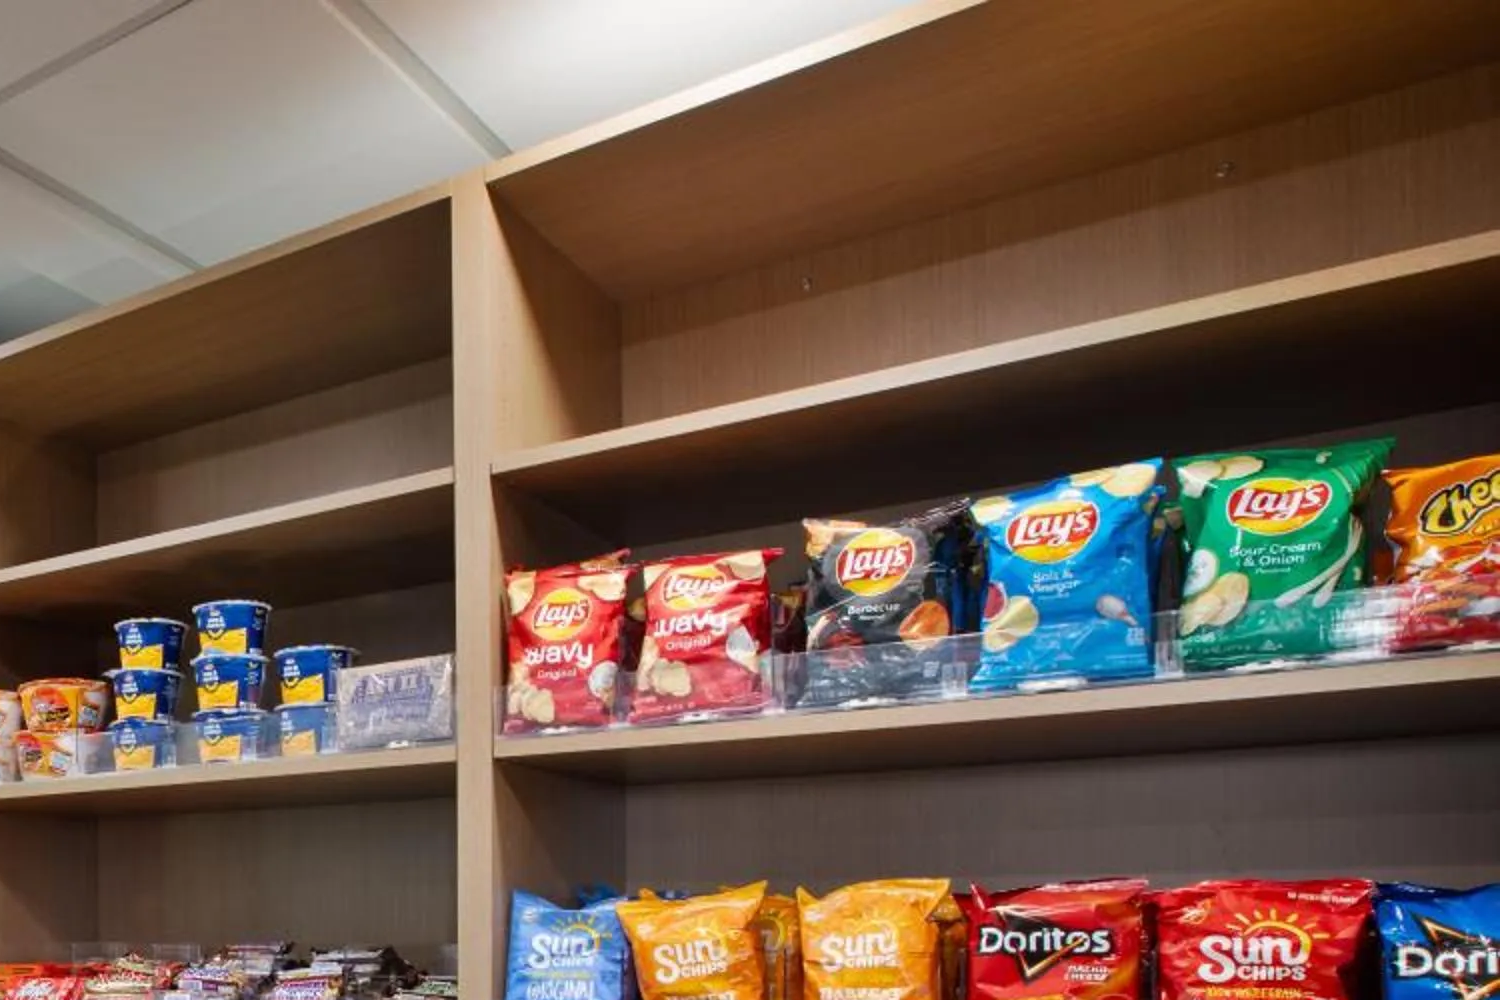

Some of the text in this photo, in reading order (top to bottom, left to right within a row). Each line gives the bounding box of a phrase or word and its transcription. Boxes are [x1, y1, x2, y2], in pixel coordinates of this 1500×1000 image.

[1234, 484, 1322, 520] Lay's
[1010, 504, 1095, 548] Lay's
[1259, 554, 1305, 567] Onion
[1269, 541, 1322, 555] Cream
[841, 544, 909, 581] Lay's
[535, 602, 588, 627] Lay's
[652, 610, 728, 637] wavy
[524, 641, 594, 668] wavy
[665, 637, 712, 650] Original
[528, 932, 598, 969] Sun
[820, 931, 897, 973] Sun
[978, 926, 1112, 954] Doritos
[653, 938, 729, 984] Sun
[1199, 934, 1308, 983] Sun
[1237, 966, 1307, 981] CHIPS
